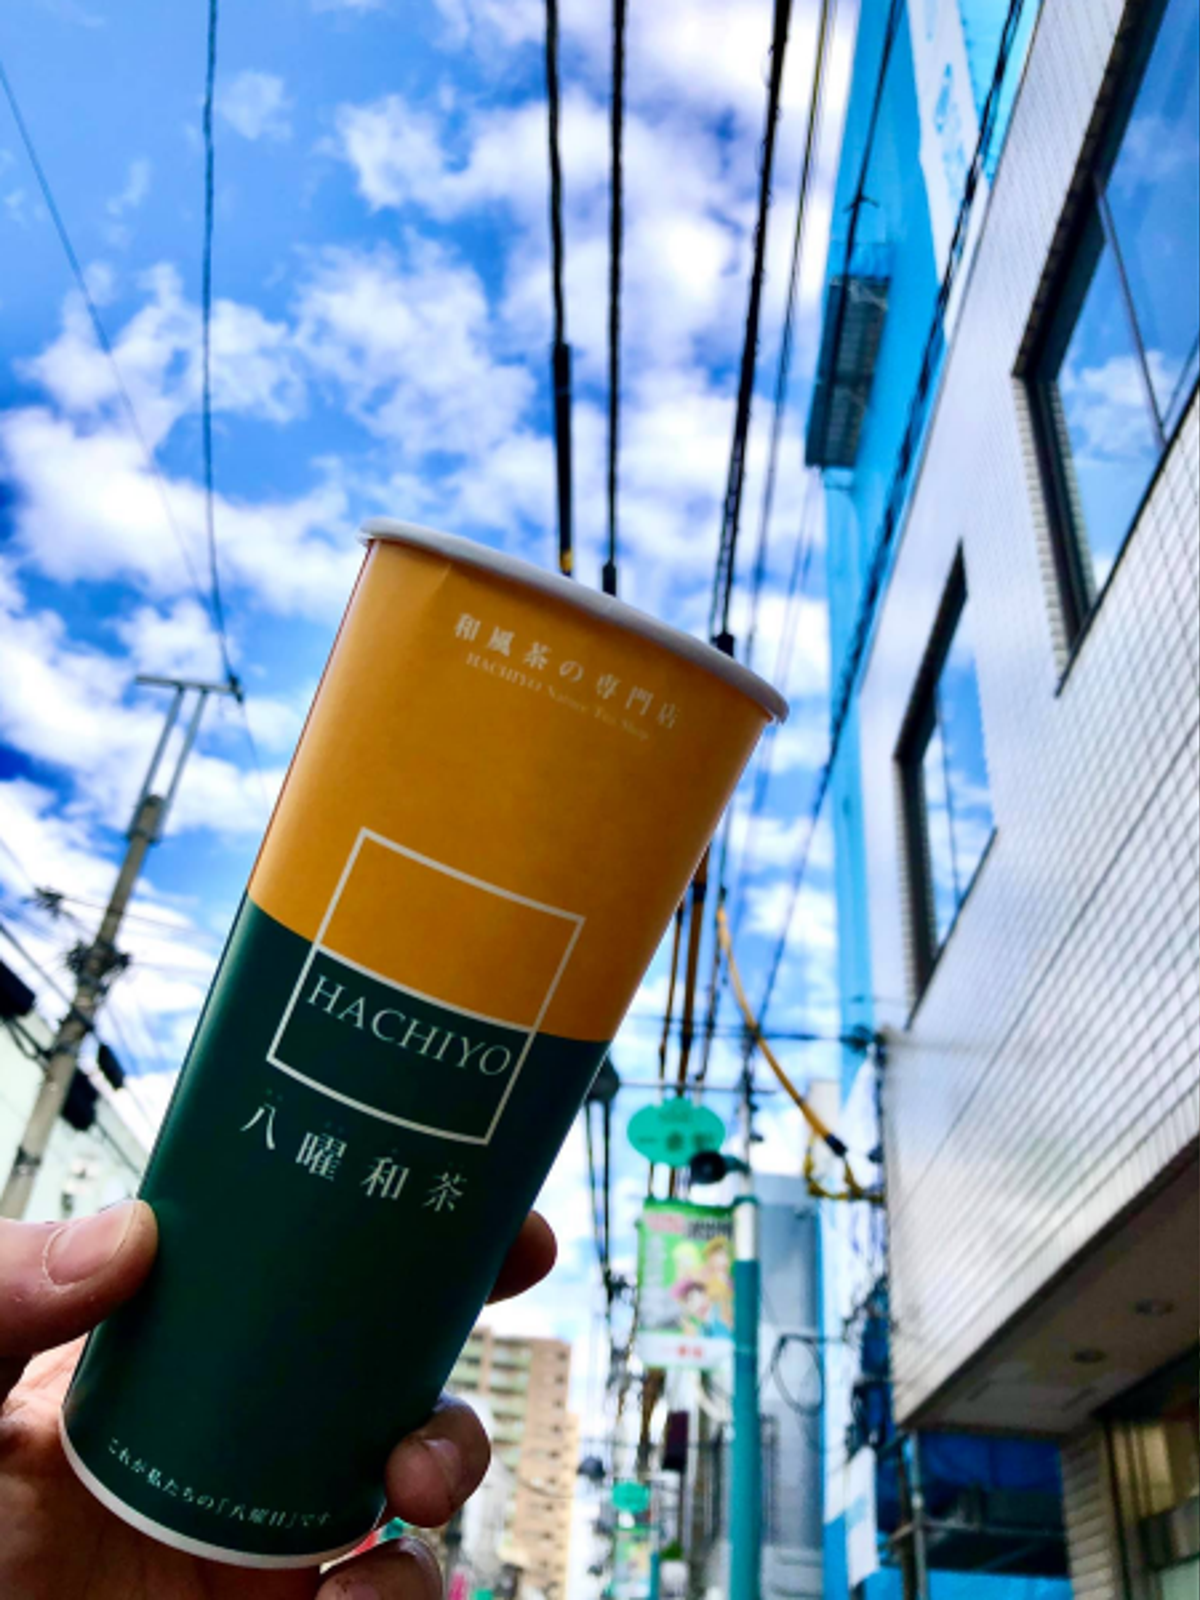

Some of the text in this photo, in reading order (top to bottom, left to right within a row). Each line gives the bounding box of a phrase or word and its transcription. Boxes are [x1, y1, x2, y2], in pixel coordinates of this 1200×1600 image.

[307, 974, 512, 1077] HACHIYO
[240, 1102, 467, 1213] 八曜和茶
